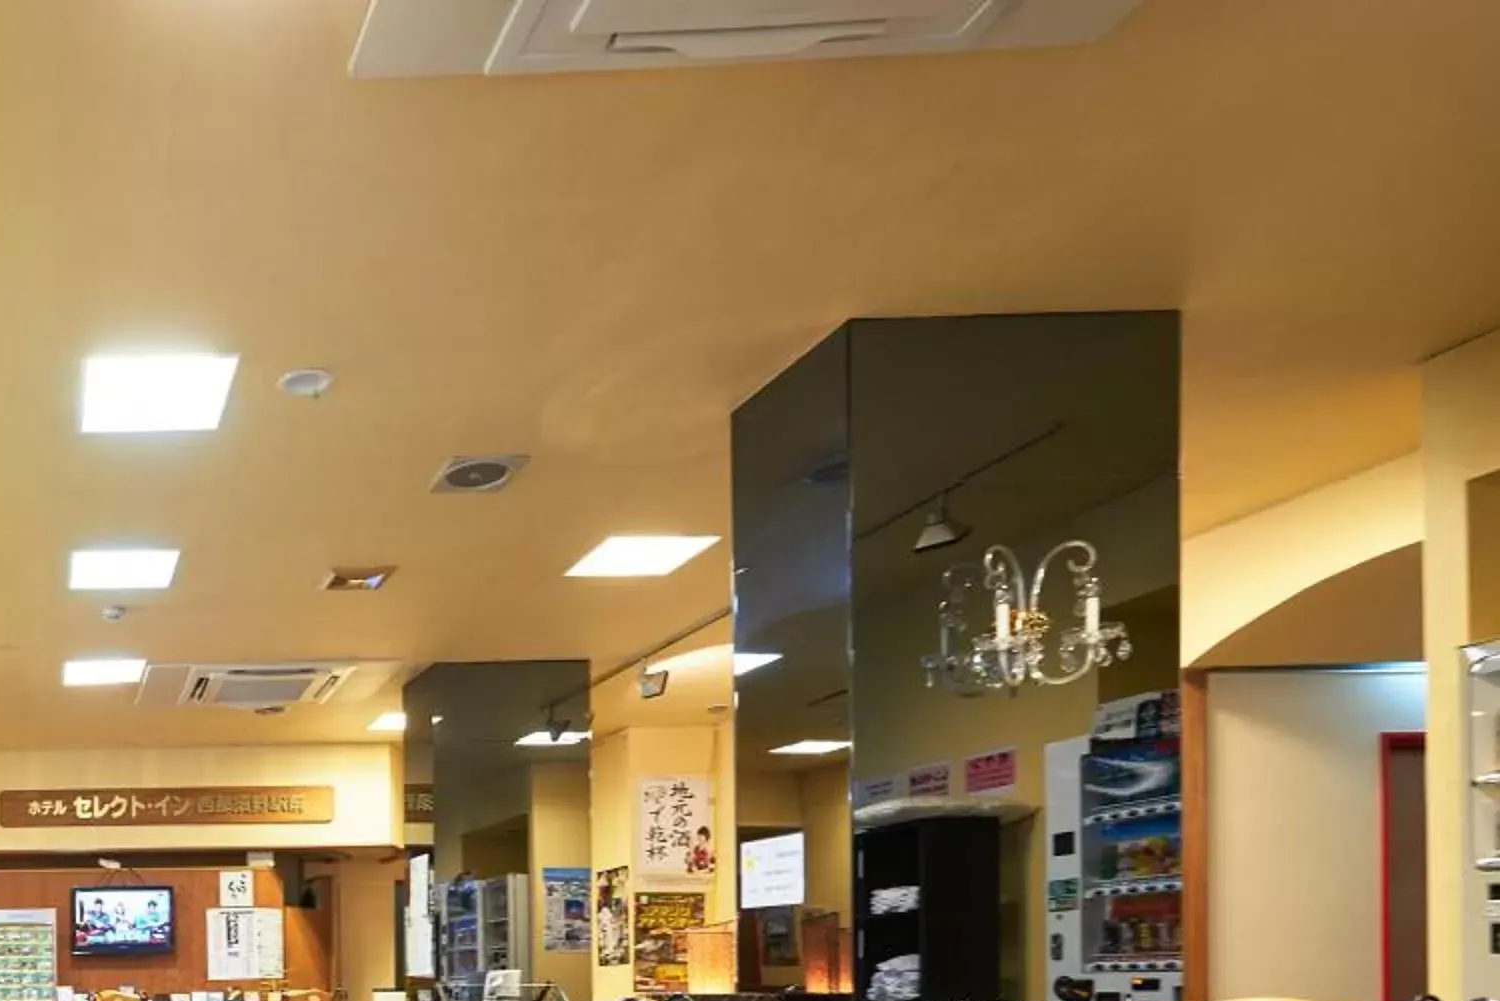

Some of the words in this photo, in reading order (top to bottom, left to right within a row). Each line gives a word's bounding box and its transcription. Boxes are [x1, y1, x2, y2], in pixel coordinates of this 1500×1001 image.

[27, 798, 68, 817] ホテル
[72, 794, 190, 819] セレクト・イン
